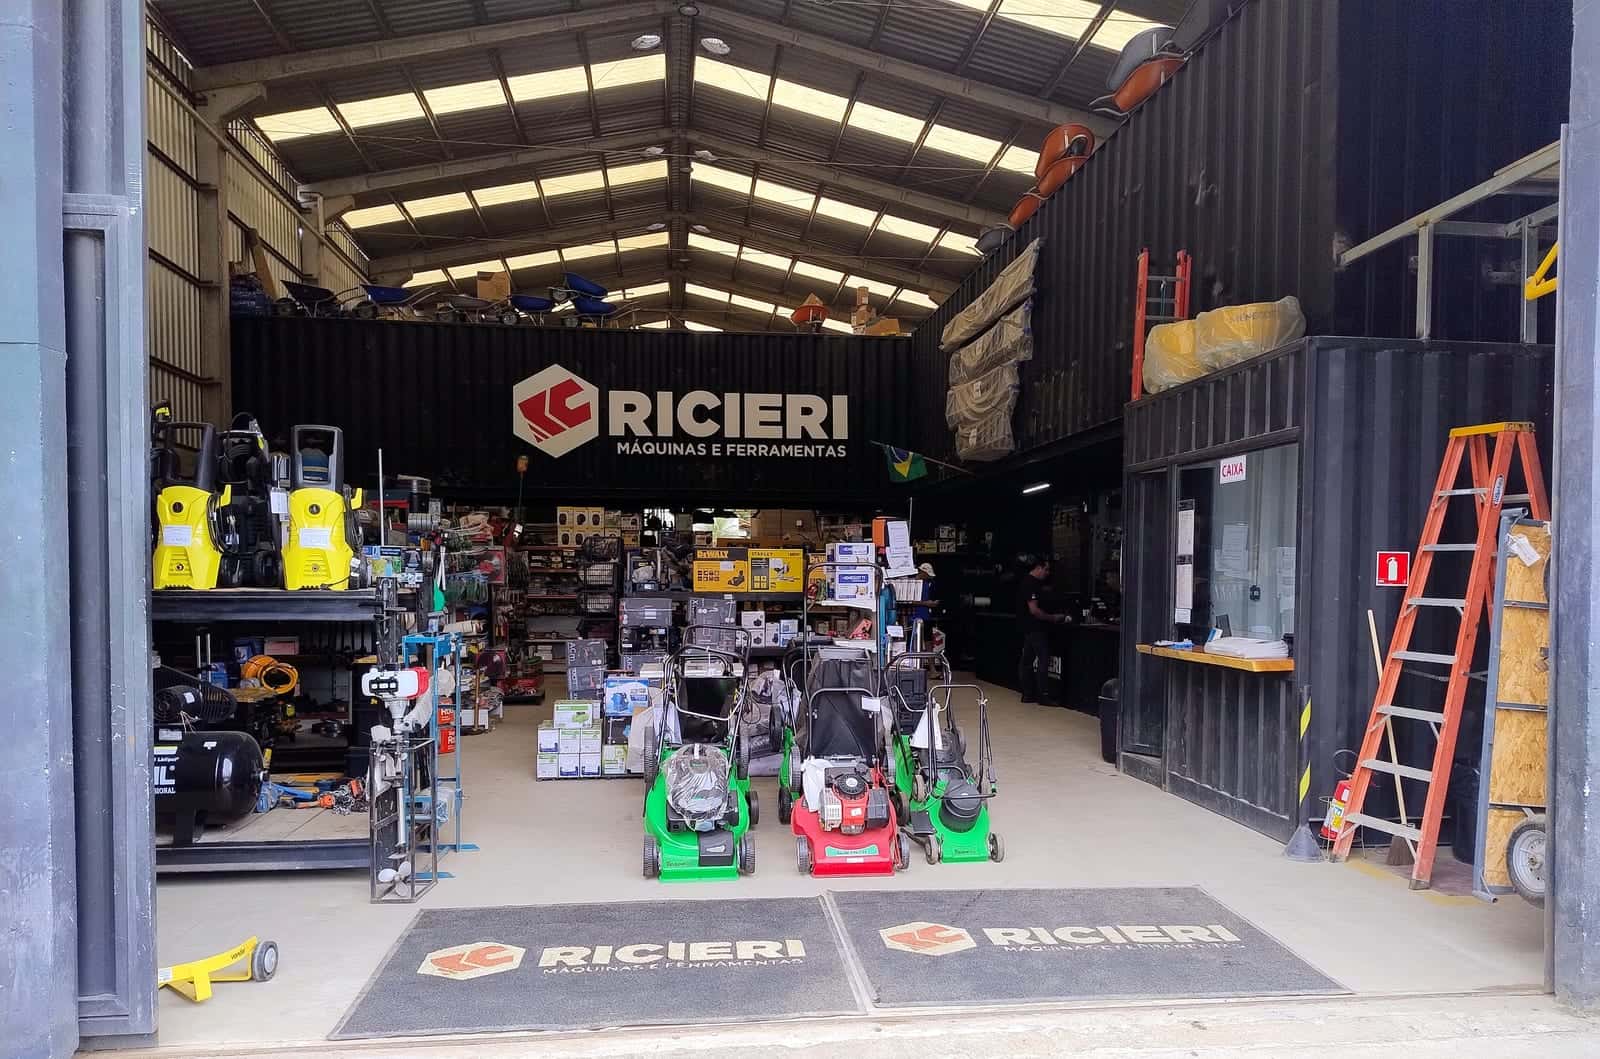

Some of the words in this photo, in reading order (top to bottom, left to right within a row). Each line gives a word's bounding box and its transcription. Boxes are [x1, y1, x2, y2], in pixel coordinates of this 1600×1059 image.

[608, 390, 849, 439] RICIERI
[617, 438, 707, 456] MÁQUINAS
[711, 443, 722, 456] E
[726, 443, 847, 457] FERRAMENTAS
[1222, 462, 1244, 477] CAIXA
[979, 925, 1241, 946] RICIERI
[538, 939, 806, 967] RICIERI
